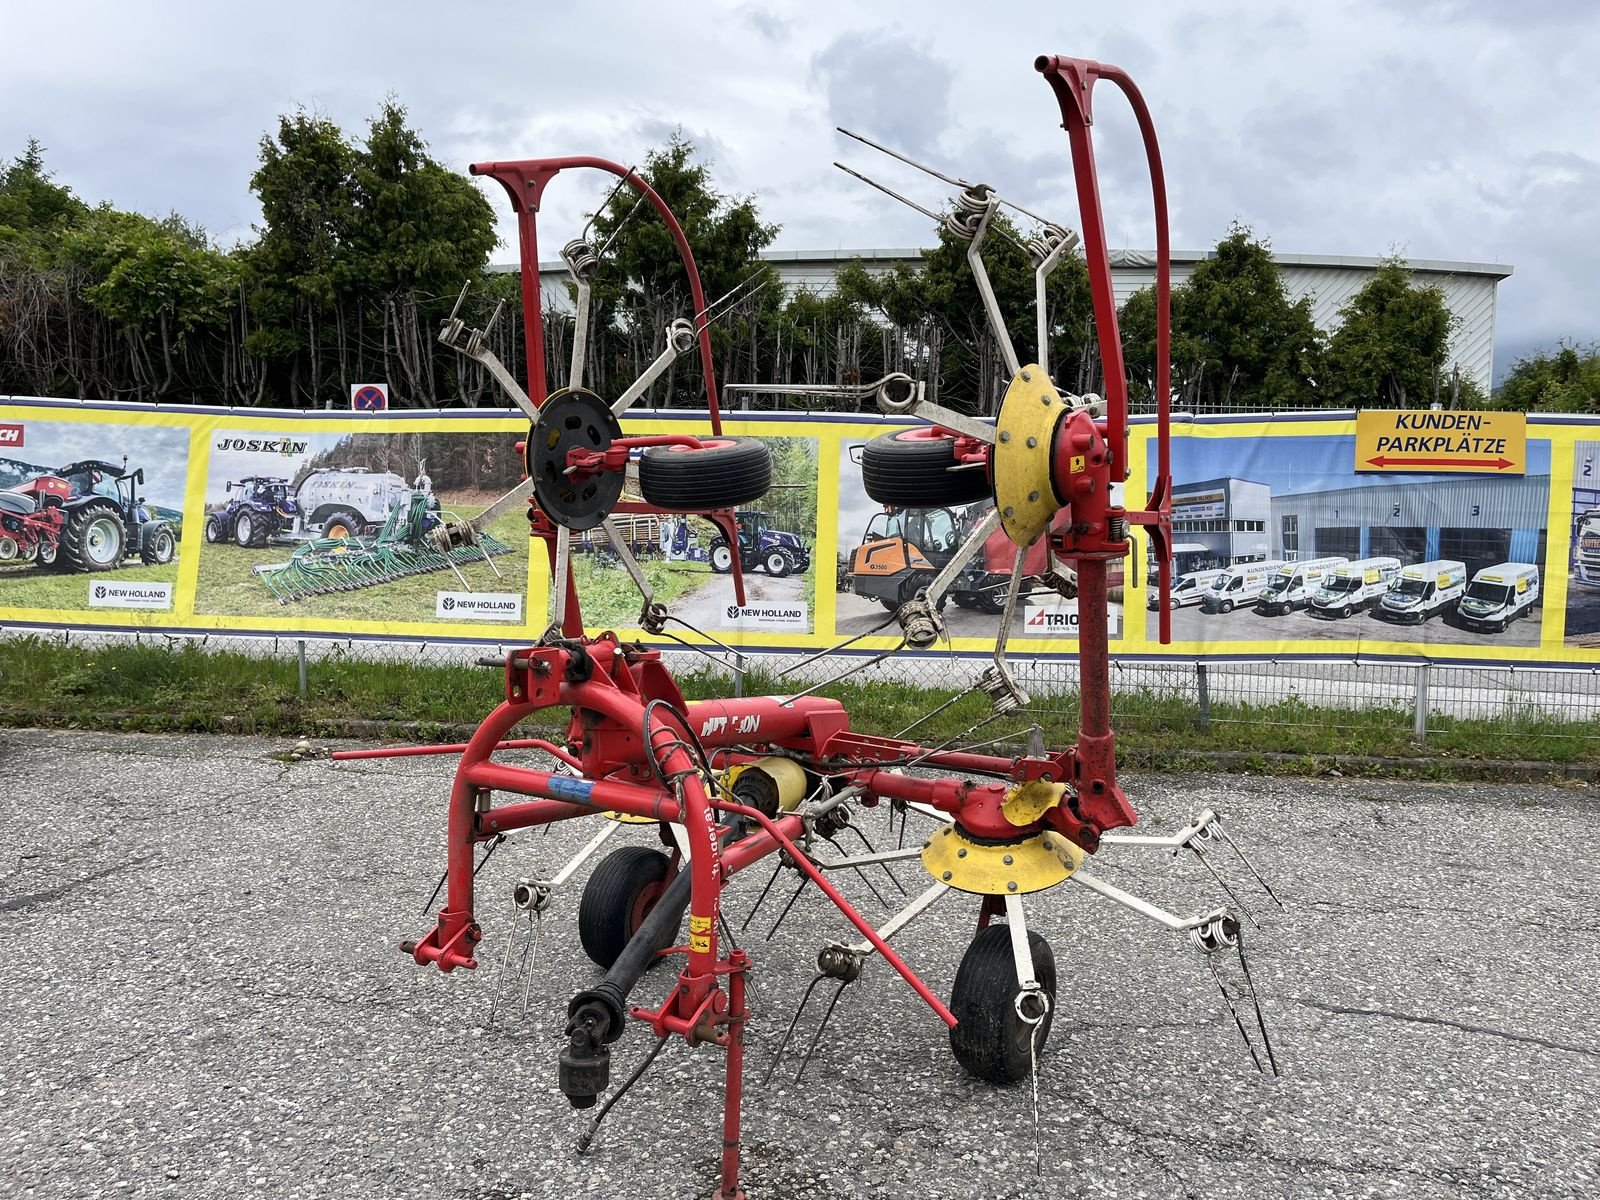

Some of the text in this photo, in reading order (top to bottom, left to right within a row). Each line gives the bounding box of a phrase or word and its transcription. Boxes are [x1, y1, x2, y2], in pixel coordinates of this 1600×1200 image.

[1395, 414, 1491, 430] KUNDEN-
[217, 438, 307, 454] JOSKIN
[1376, 433, 1506, 454] PARKPLÄTZE
[1583, 465, 1592, 477] 2
[1393, 507, 1400, 518] 2
[1471, 505, 1480, 517] 3
[108, 589, 166, 598] NEW HOLLAND
[457, 600, 516, 610] NEW HOLLAND
[741, 608, 802, 618] NEW HOLLAND
